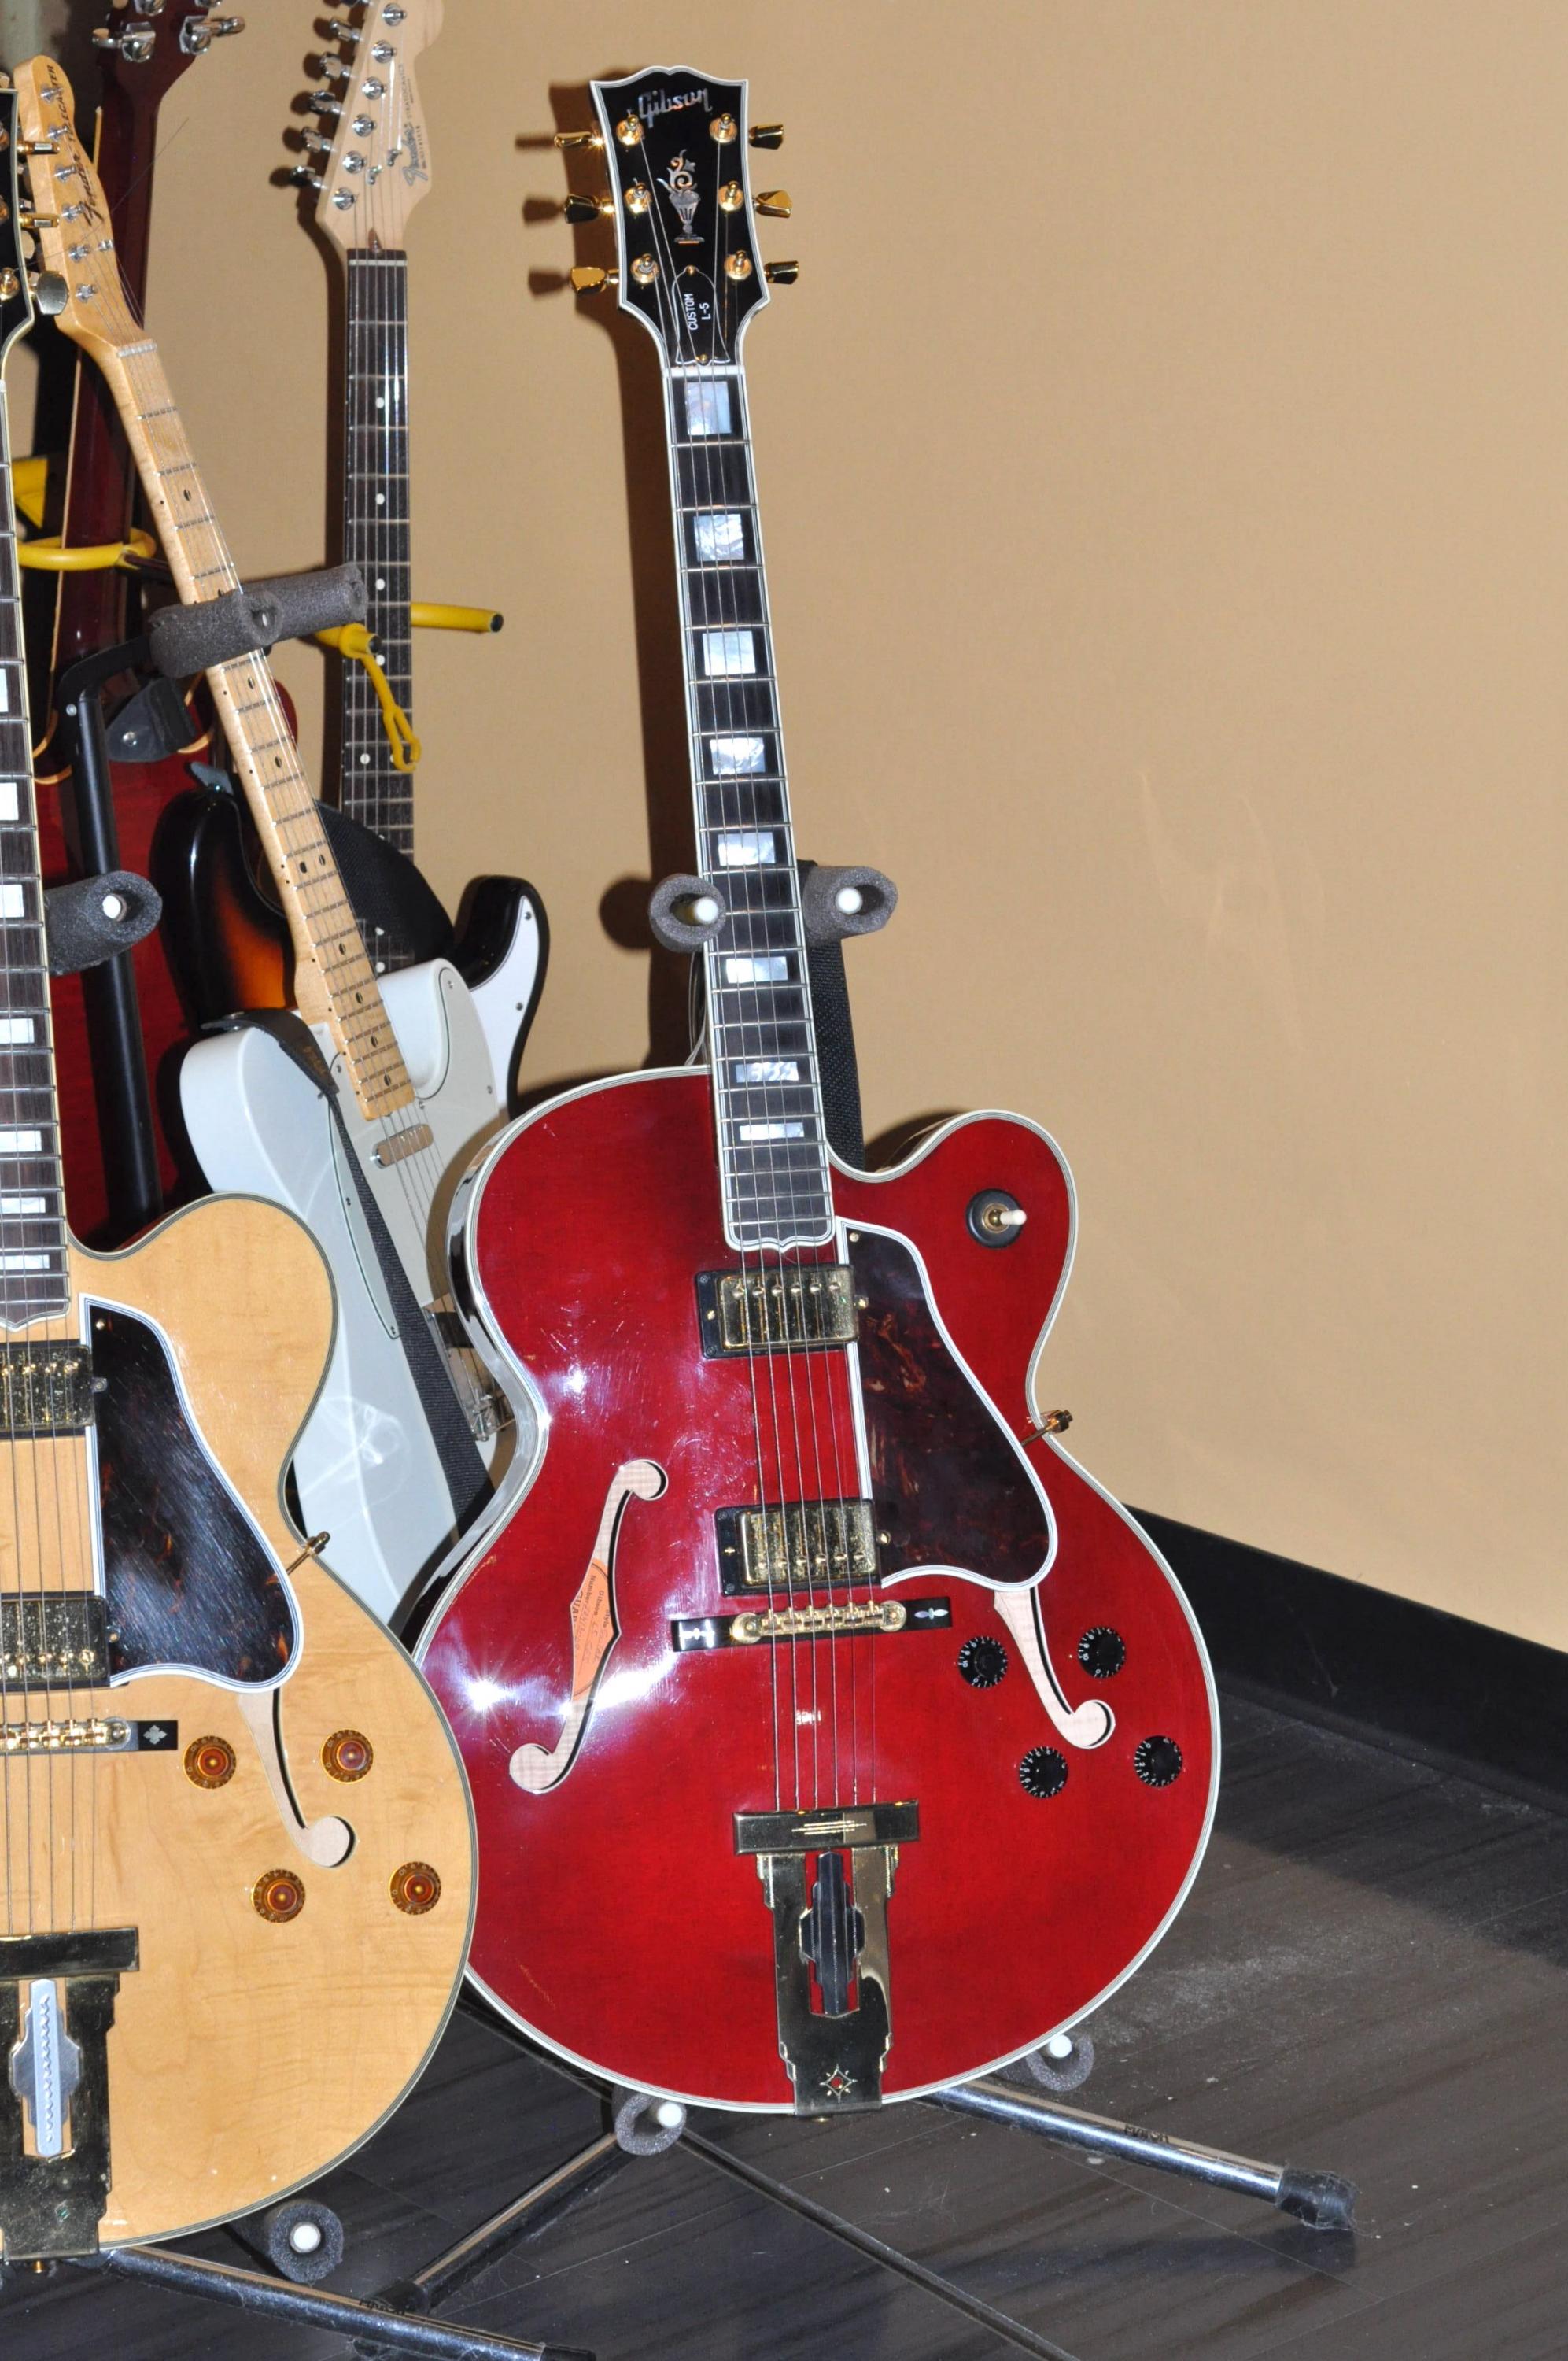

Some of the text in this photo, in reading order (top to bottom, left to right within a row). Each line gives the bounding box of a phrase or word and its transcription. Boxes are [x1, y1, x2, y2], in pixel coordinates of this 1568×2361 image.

[47, 65, 76, 142] TELECATER
[638, 87, 713, 128] Gibson
[402, 122, 428, 186] Fender
[683, 293, 699, 331] CUSTOM
[699, 302, 711, 320] L-5
